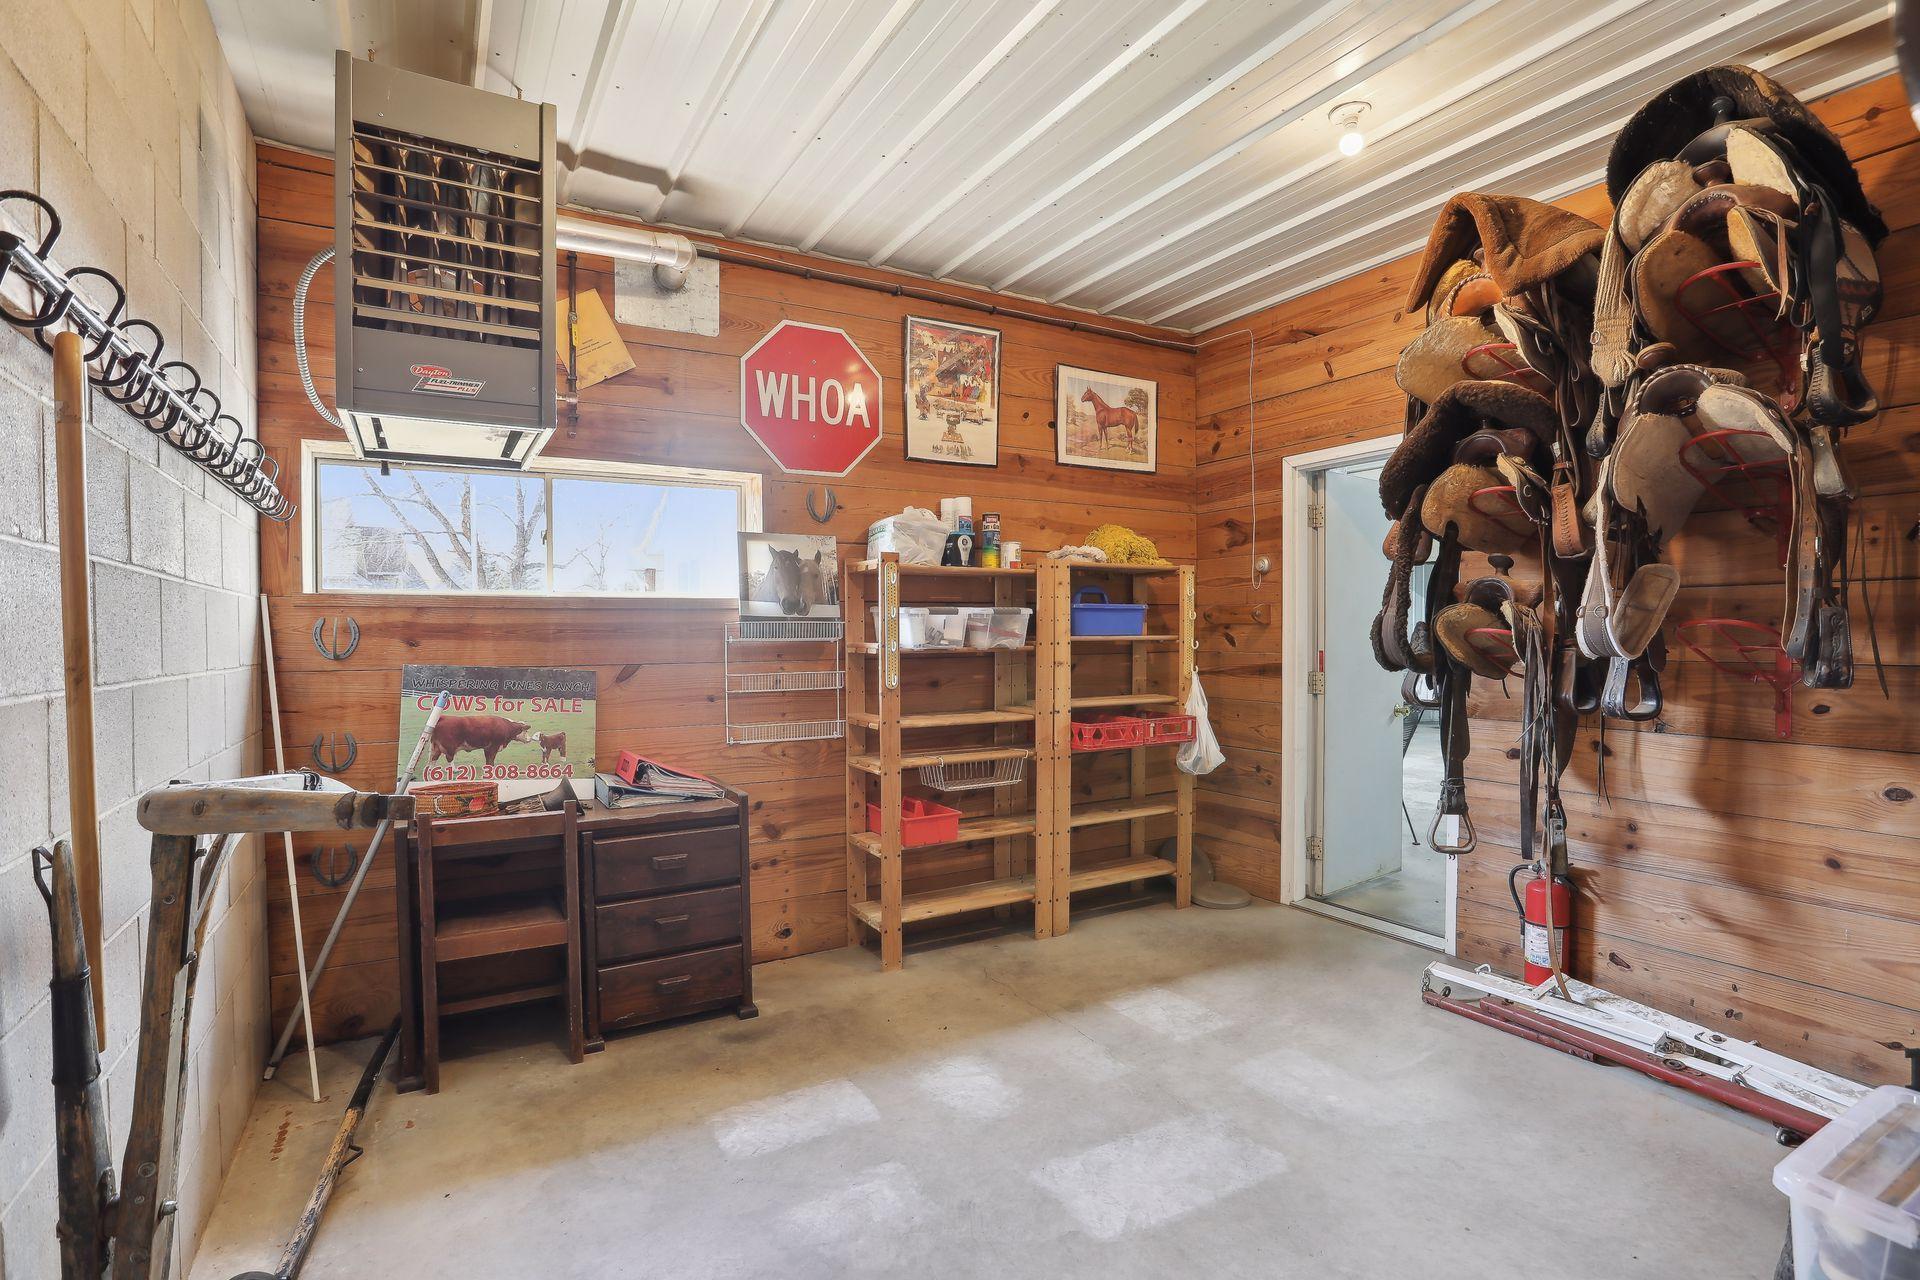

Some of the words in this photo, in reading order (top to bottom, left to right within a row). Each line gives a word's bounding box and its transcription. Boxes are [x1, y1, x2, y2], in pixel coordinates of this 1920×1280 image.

[415, 366, 449, 377] Dayton
[430, 378, 480, 388] FUEL-TRIMMER
[755, 369, 871, 429] WHOA
[412, 678, 499, 690] WHISPERING
[503, 680, 542, 691] PINES
[546, 682, 591, 692] RANCH
[494, 694, 525, 712] for
[531, 696, 583, 713] SALE
[423, 765, 476, 781] (612)
[482, 764, 574, 780] 308-8664
